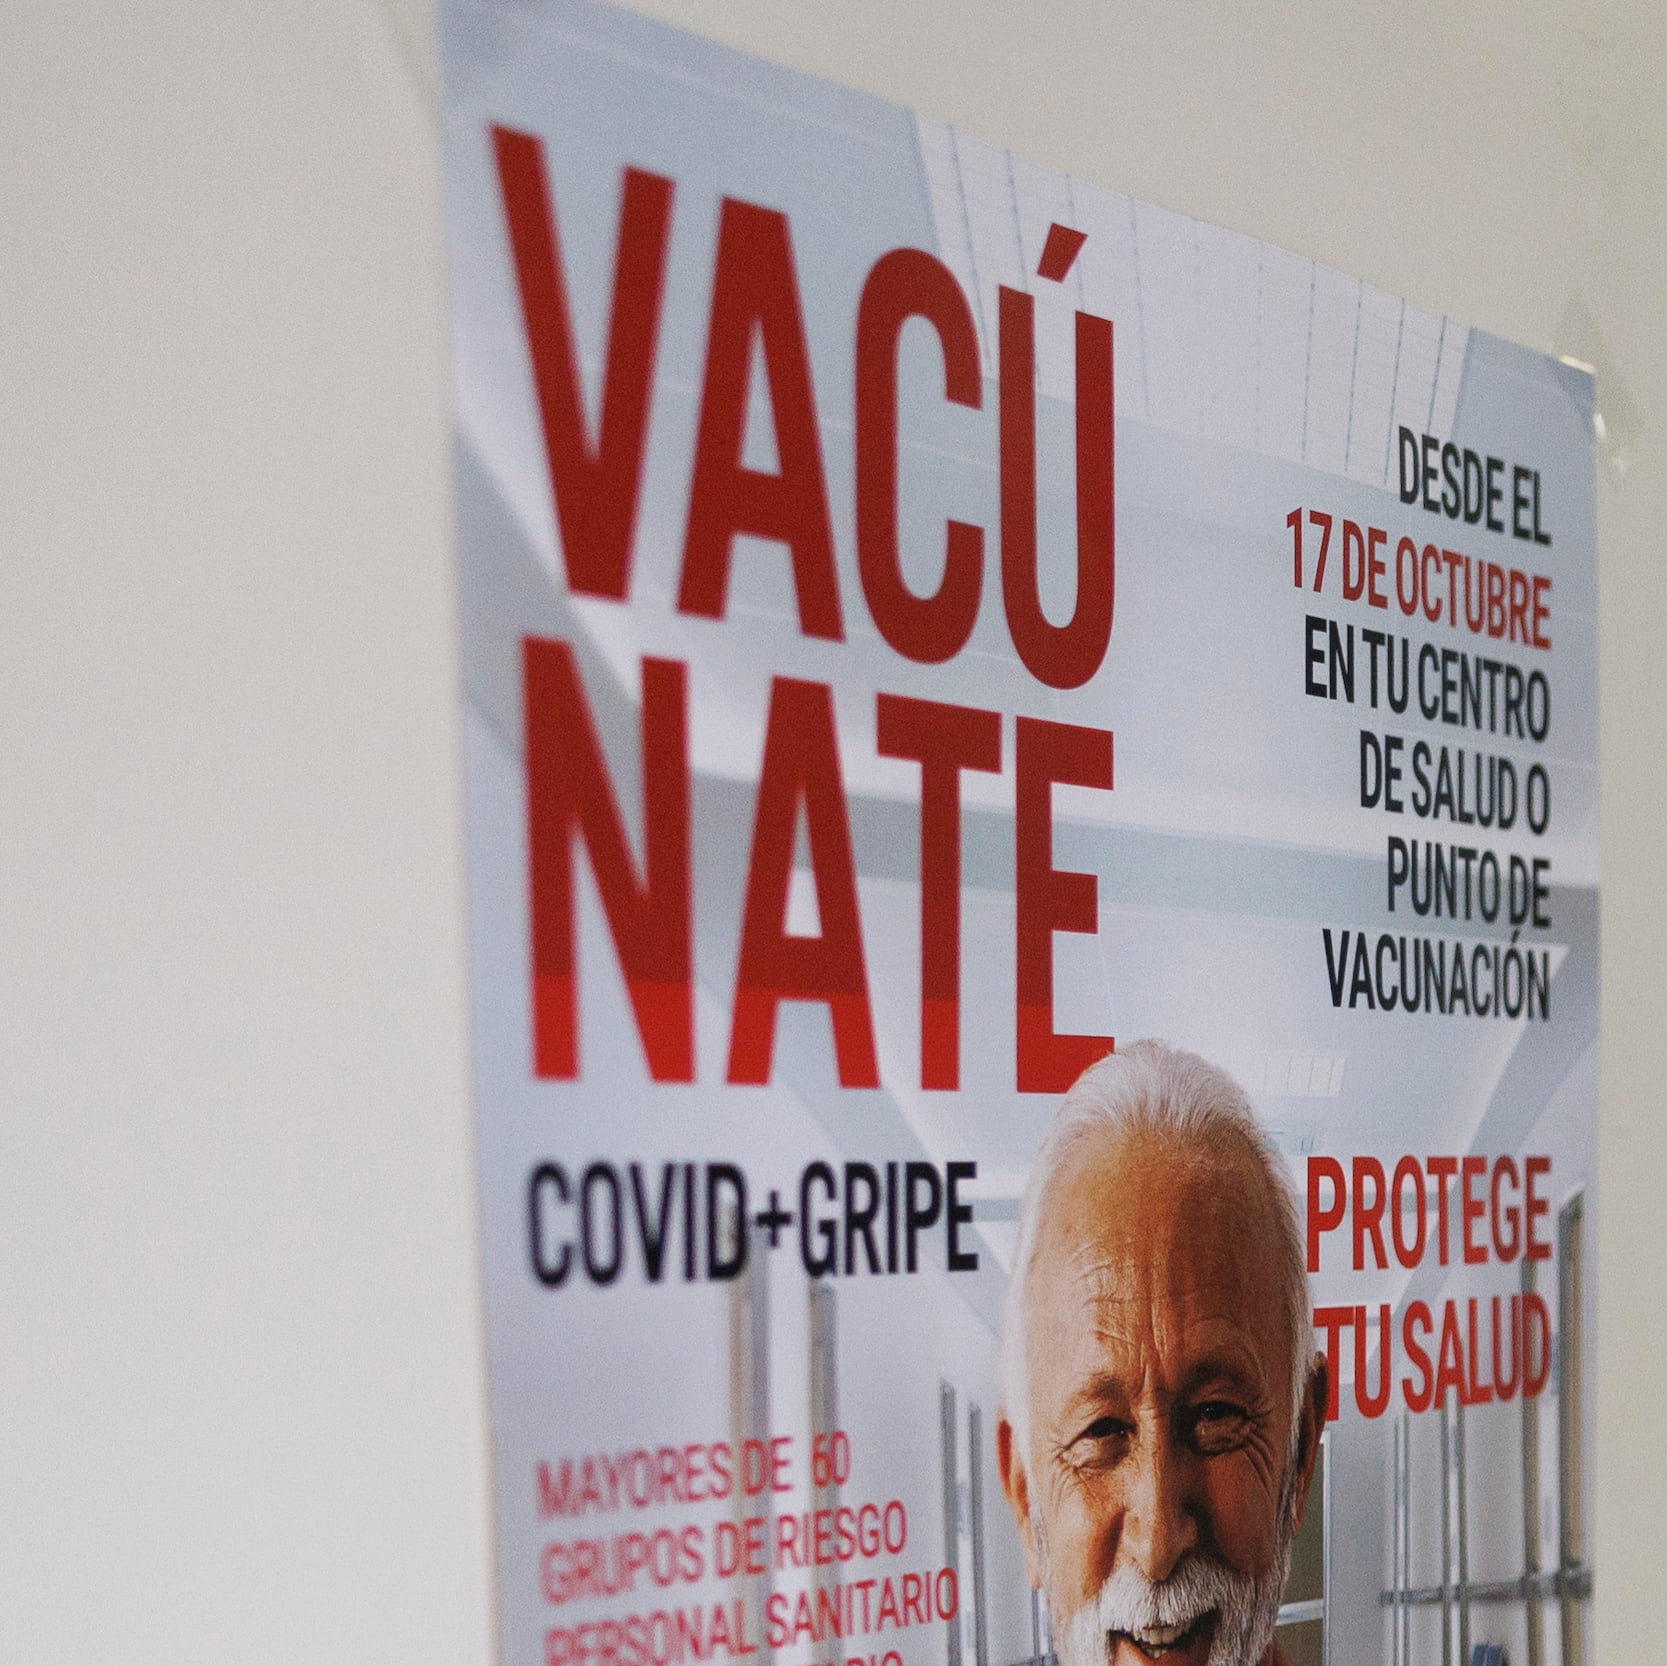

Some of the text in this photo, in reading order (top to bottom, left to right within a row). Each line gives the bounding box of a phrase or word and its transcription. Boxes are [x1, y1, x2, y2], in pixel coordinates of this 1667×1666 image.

[485, 120, 1116, 690] VACÚ
[1399, 425, 1552, 547] DESDE EL
[1286, 506, 1552, 651] 17 DE OCTUBRE
[1304, 614, 1551, 744] EN TU CENTRO
[1359, 729, 1550, 836] DE SALUD O
[520, 634, 1116, 1094] NATE
[1387, 835, 1552, 929] PUNTO DE
[1322, 927, 1551, 1022] VACUNACIÓN
[527, 1159, 980, 1288] COVID+GRIPE
[1306, 1154, 1553, 1273] PROTEGE
[1312, 1292, 1552, 1422] TU SALUD
[535, 1430, 851, 1523] MAYORES DE 60
[539, 1500, 908, 1605] GRUPOS DE RIESGO
[765, 1567, 958, 1648] SANITARIO
